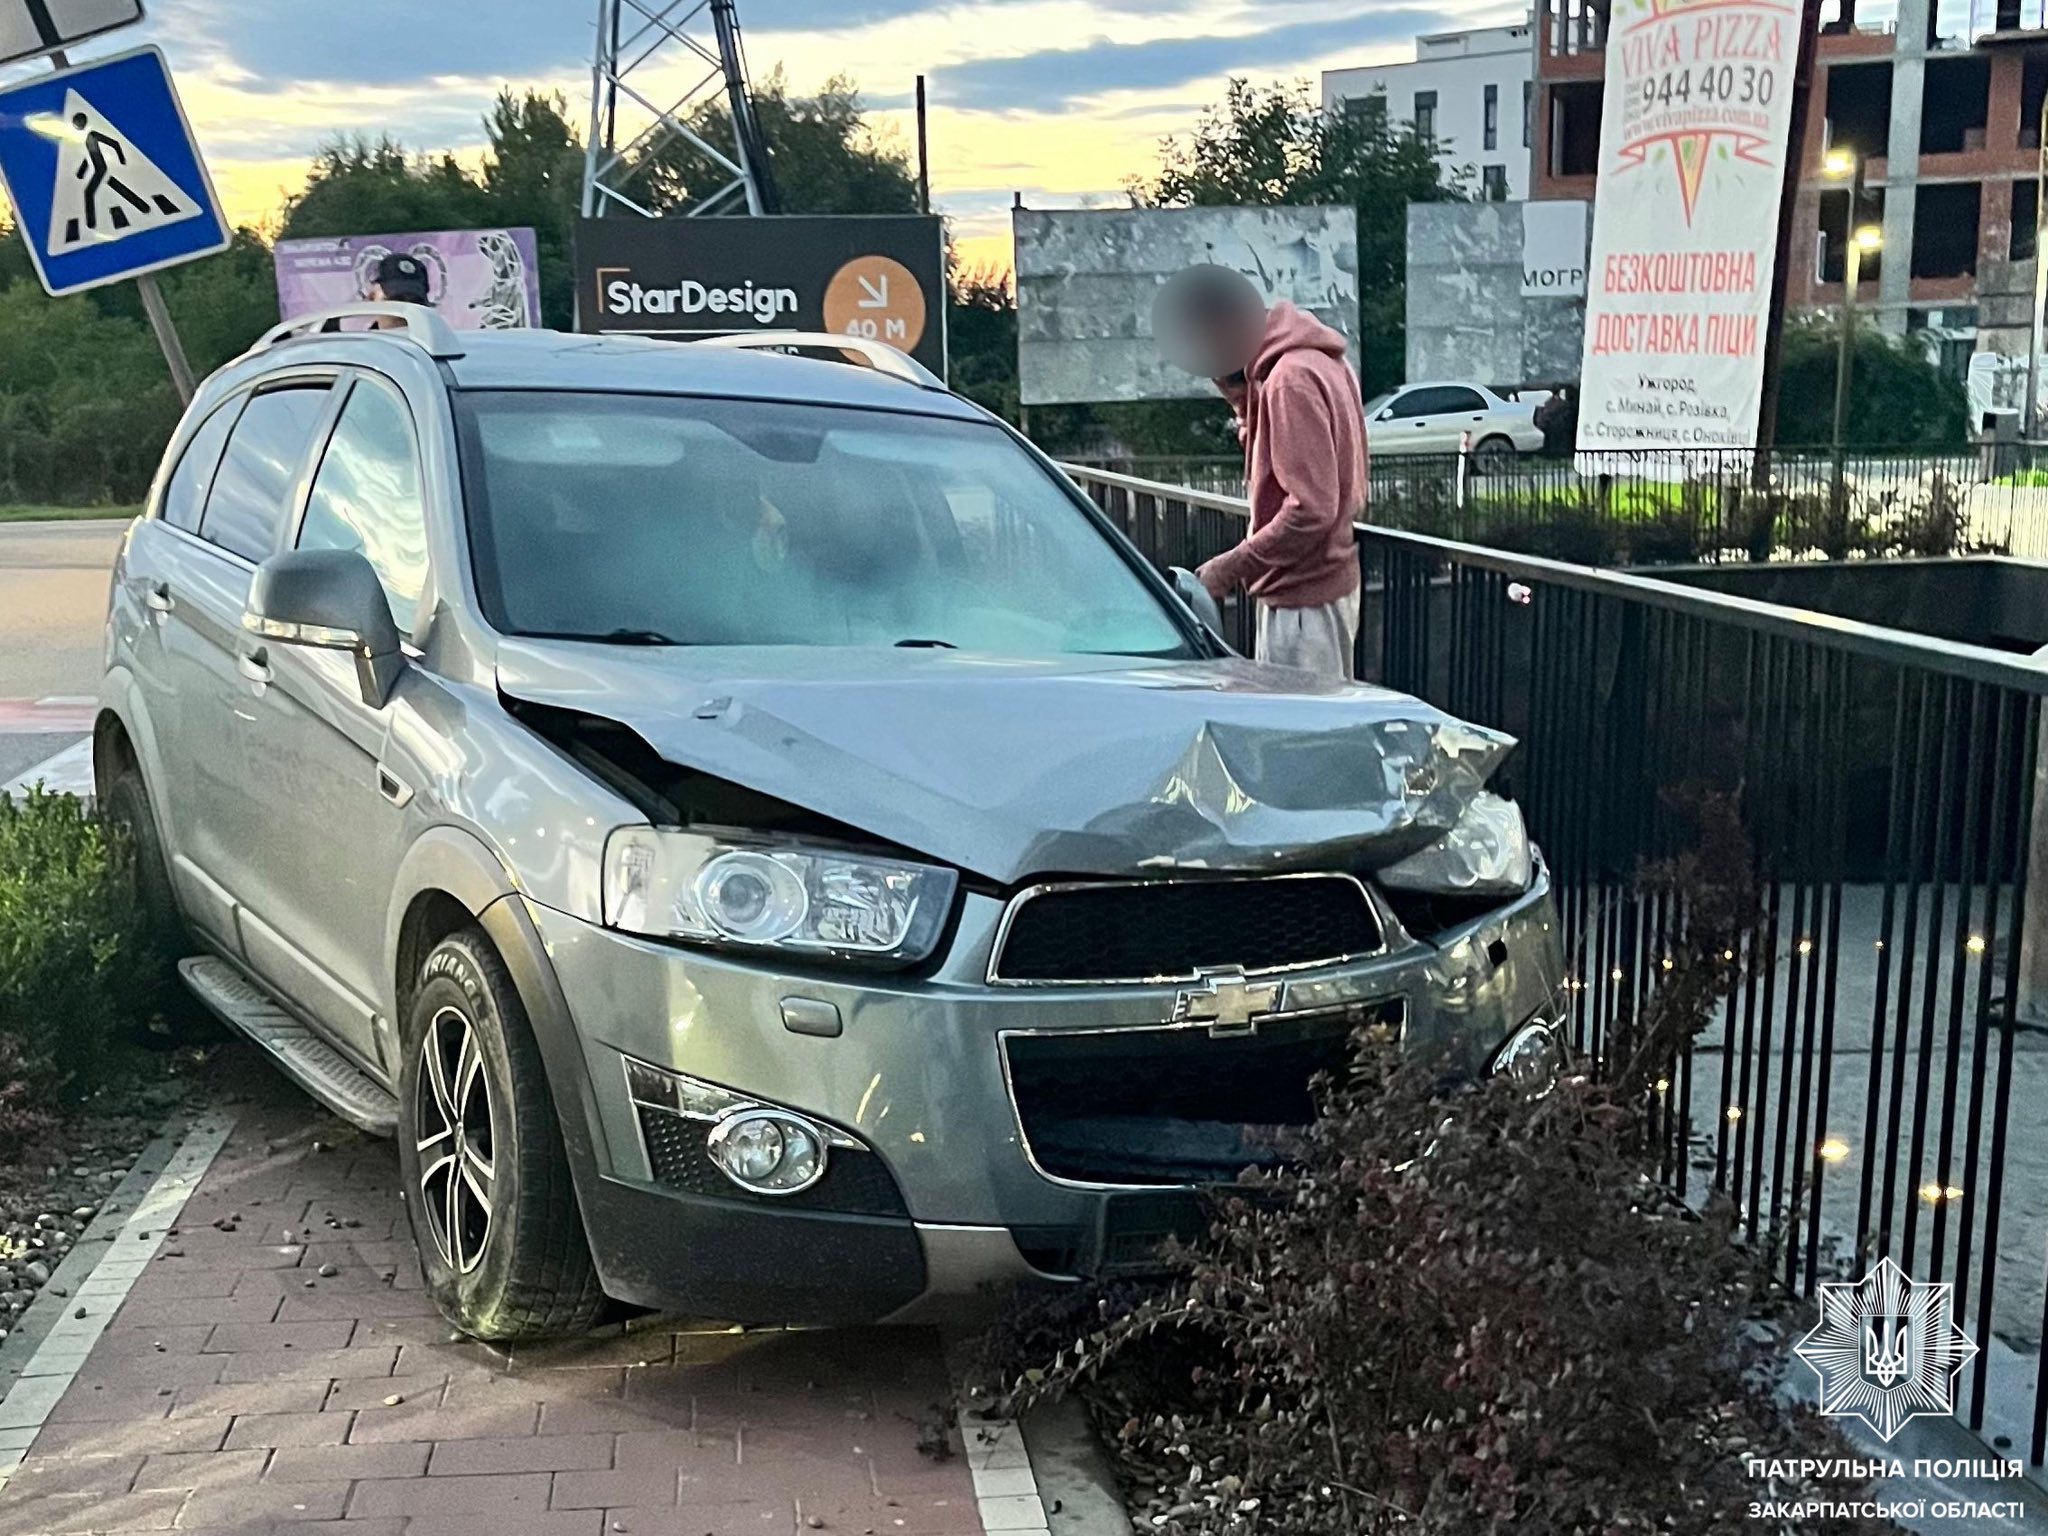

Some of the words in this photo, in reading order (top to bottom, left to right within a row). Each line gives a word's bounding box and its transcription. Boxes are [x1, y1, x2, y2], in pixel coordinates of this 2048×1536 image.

[1622, 22, 1681, 78] VIVA
[1693, 14, 1783, 61] PIZZA
[1643, 69, 1691, 113] 944
[1700, 65, 1733, 101] 40
[1740, 67, 1773, 106] 30
[1604, 252, 1756, 293] БЕЗКОШТОВНА
[607, 280, 798, 323] StarDesign
[846, 318, 877, 339] 40
[1593, 313, 1700, 355] ДОСТАВКА
[1705, 313, 1758, 358] ПІЦИ
